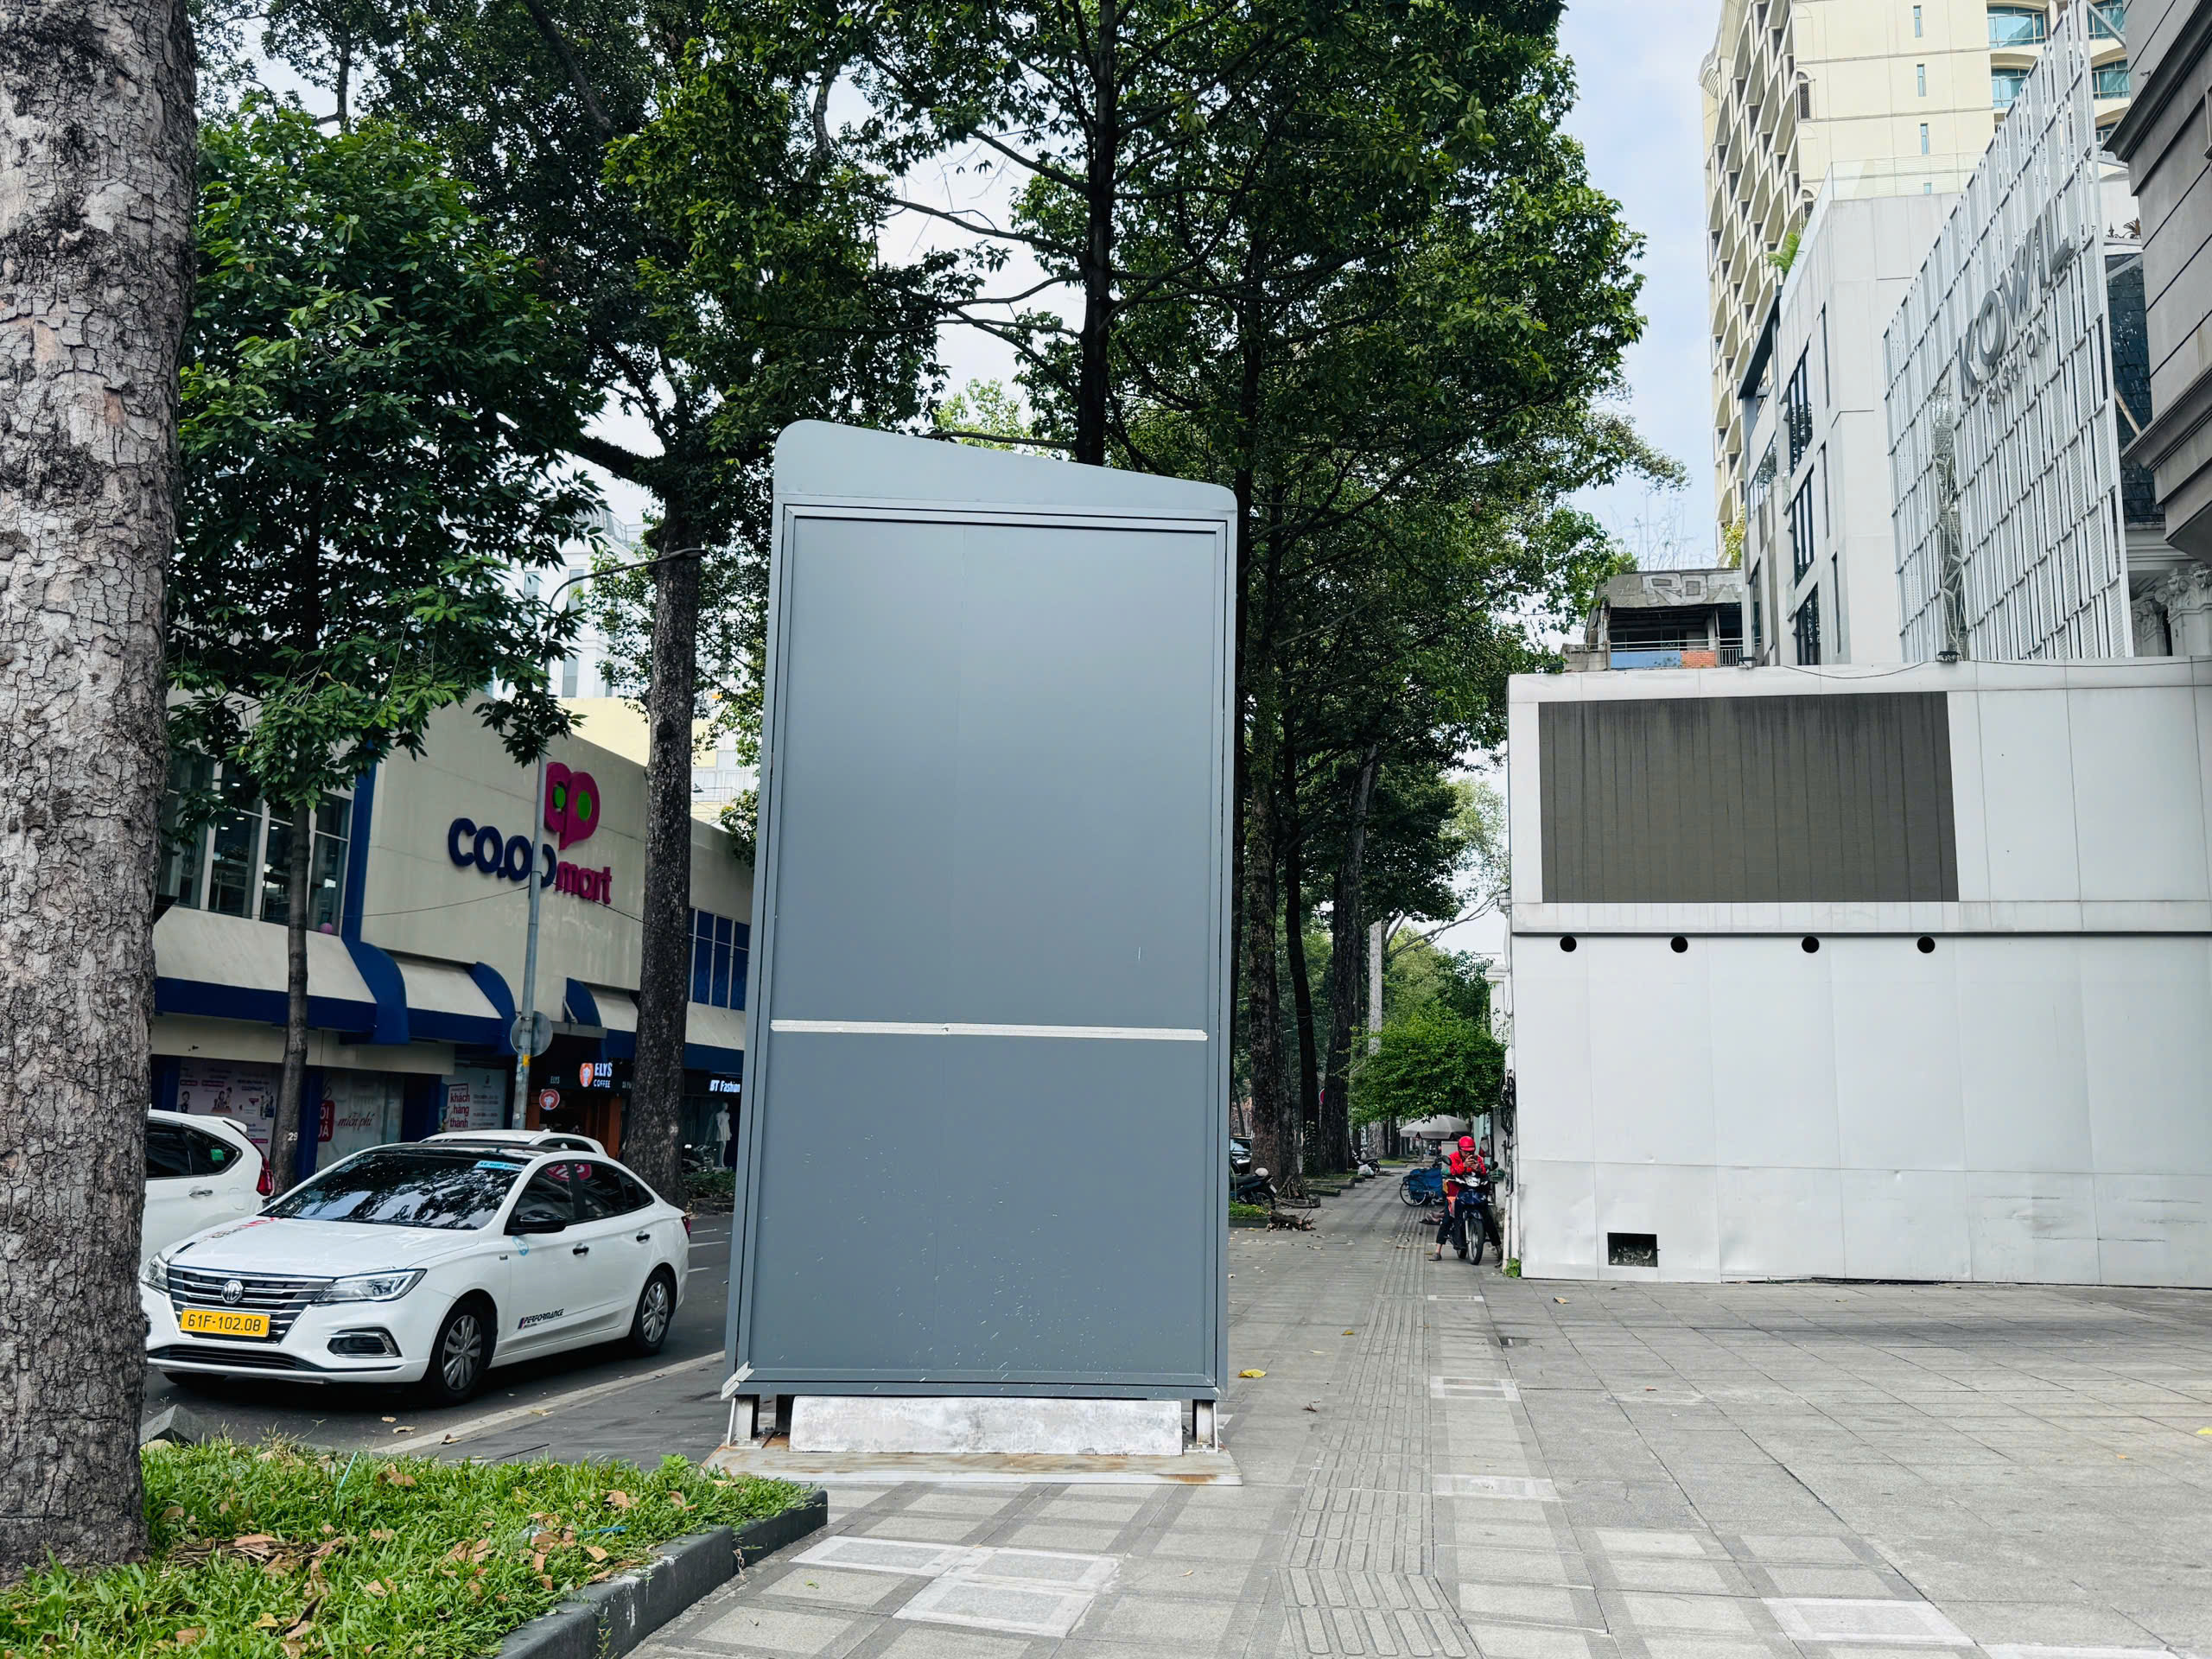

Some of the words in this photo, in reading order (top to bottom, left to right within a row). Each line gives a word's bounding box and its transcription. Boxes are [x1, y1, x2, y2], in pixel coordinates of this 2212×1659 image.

[1958, 198, 2075, 402] KOWIL
[594, 1062, 613, 1077] ELYS
[593, 1079, 611, 1089] COFFEE
[709, 1079, 720, 1092] BT
[450, 1092, 471, 1103] khách
[288, 1132, 298, 1141] 29
[188, 1314, 262, 1332] 61F-102.08
